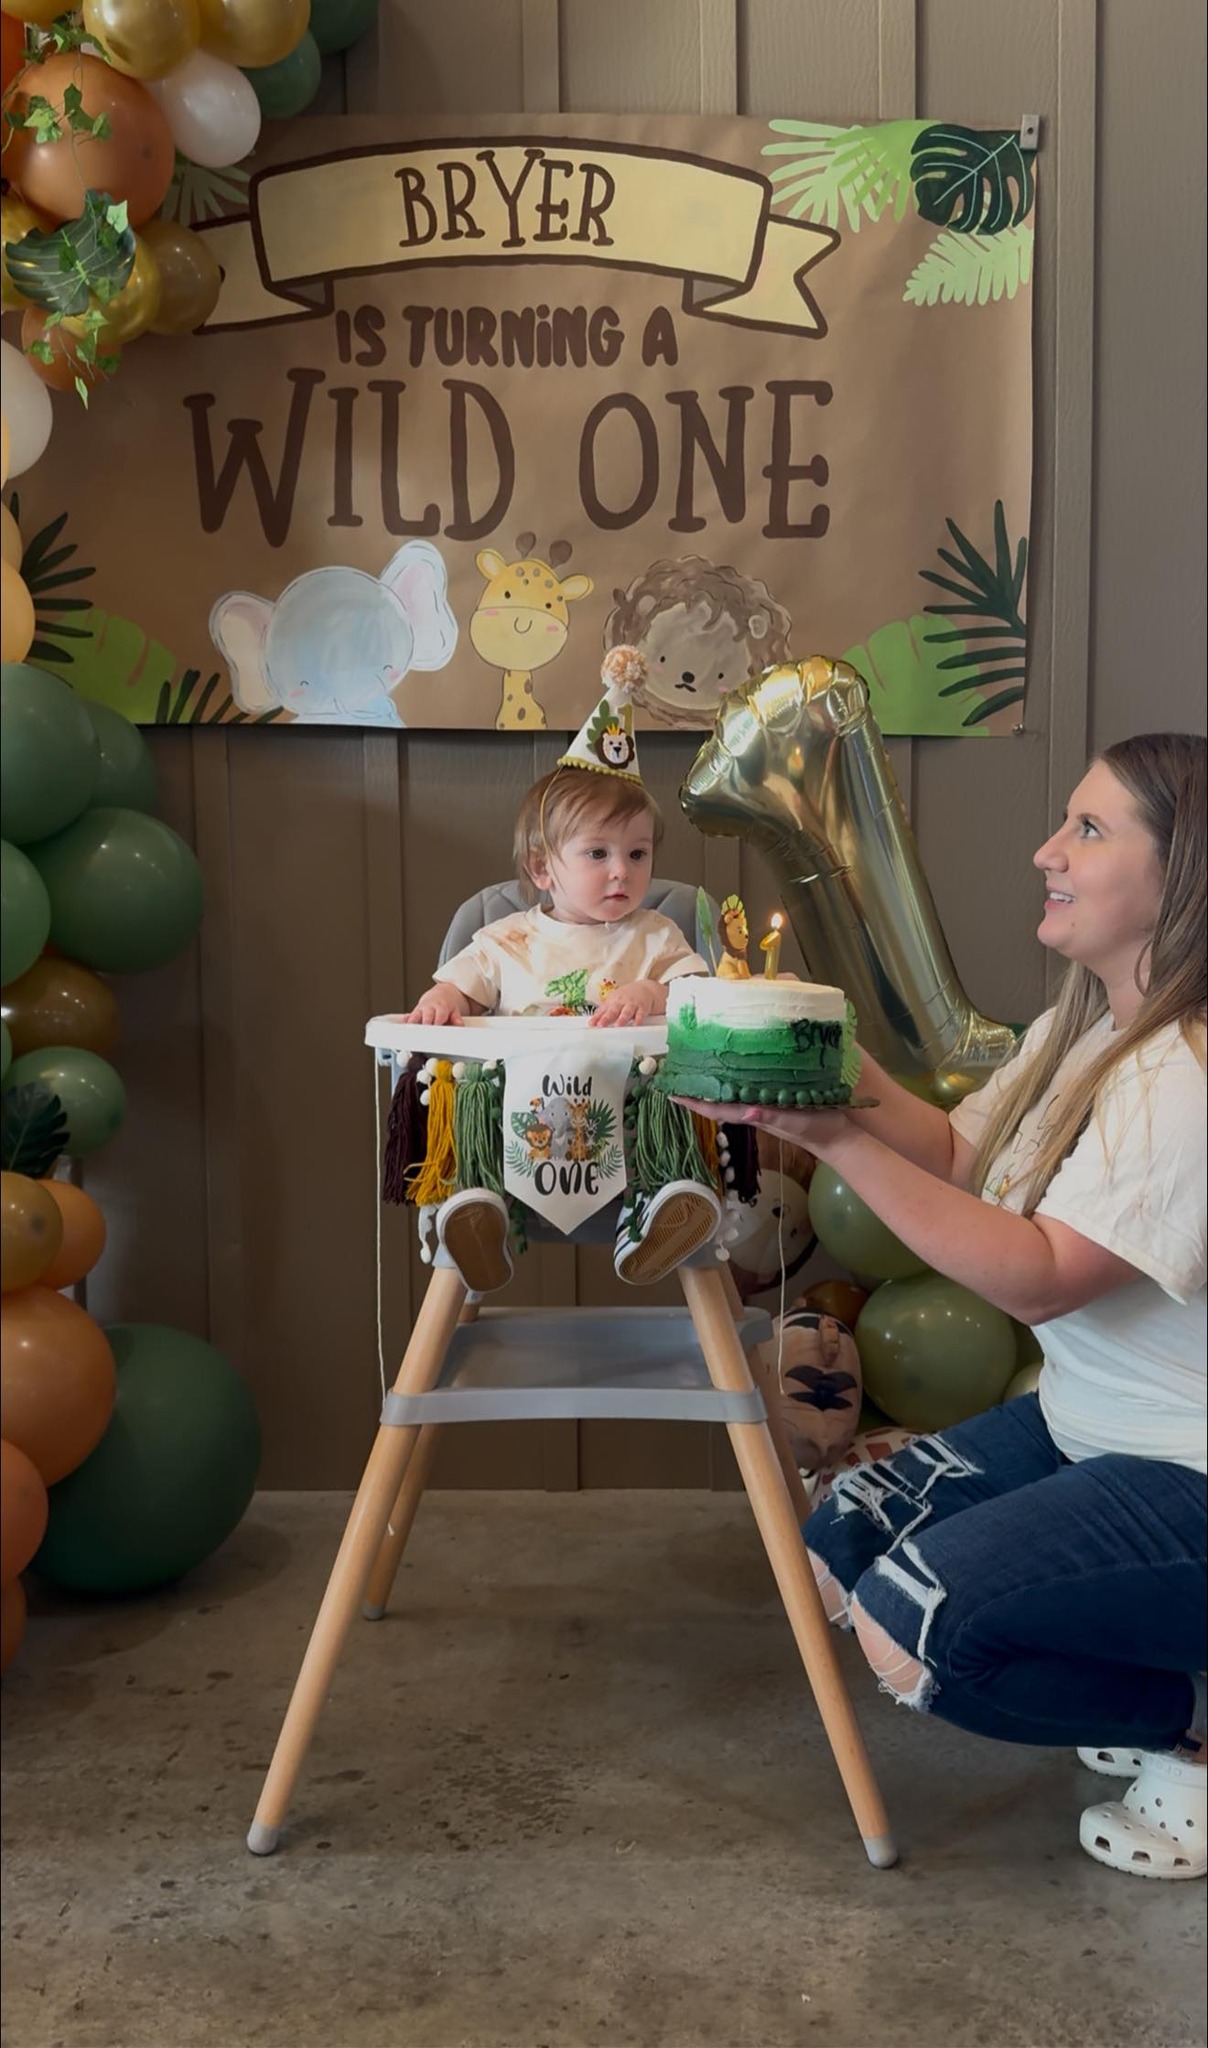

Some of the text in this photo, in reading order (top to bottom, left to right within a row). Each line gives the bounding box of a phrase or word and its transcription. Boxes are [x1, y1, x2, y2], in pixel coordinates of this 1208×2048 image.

[395, 148, 615, 248] BRYER
[335, 306, 387, 367] IS
[641, 306, 679, 367] A
[183, 367, 833, 547] WILD ONE
[542, 1074, 592, 1097] Wild
